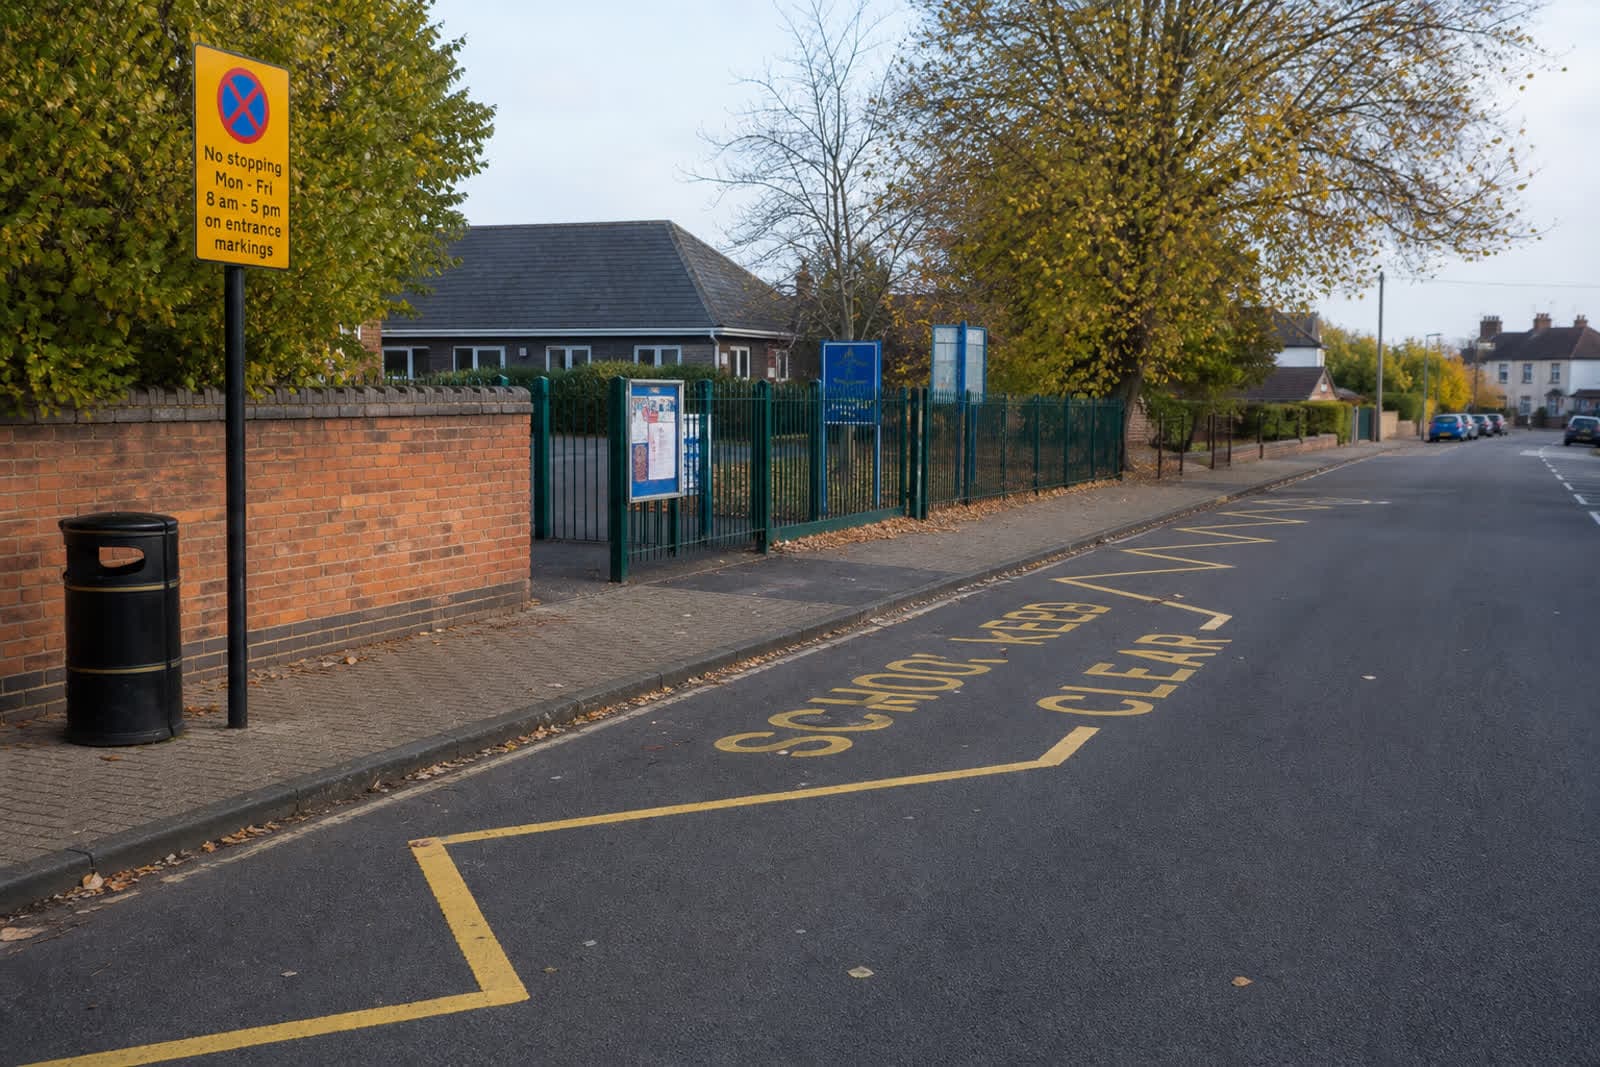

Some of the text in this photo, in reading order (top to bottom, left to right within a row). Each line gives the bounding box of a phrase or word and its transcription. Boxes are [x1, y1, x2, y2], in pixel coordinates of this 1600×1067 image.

[204, 145, 282, 177] No stopping
[215, 170, 243, 190] Mon
[257, 179, 273, 196] Fri
[206, 191, 215, 206] 8
[219, 197, 239, 211] am
[251, 198, 259, 214] 5
[262, 204, 281, 219] pm
[205, 216, 281, 259] on entrance markings
[1036, 633, 1233, 716] CLEAR
